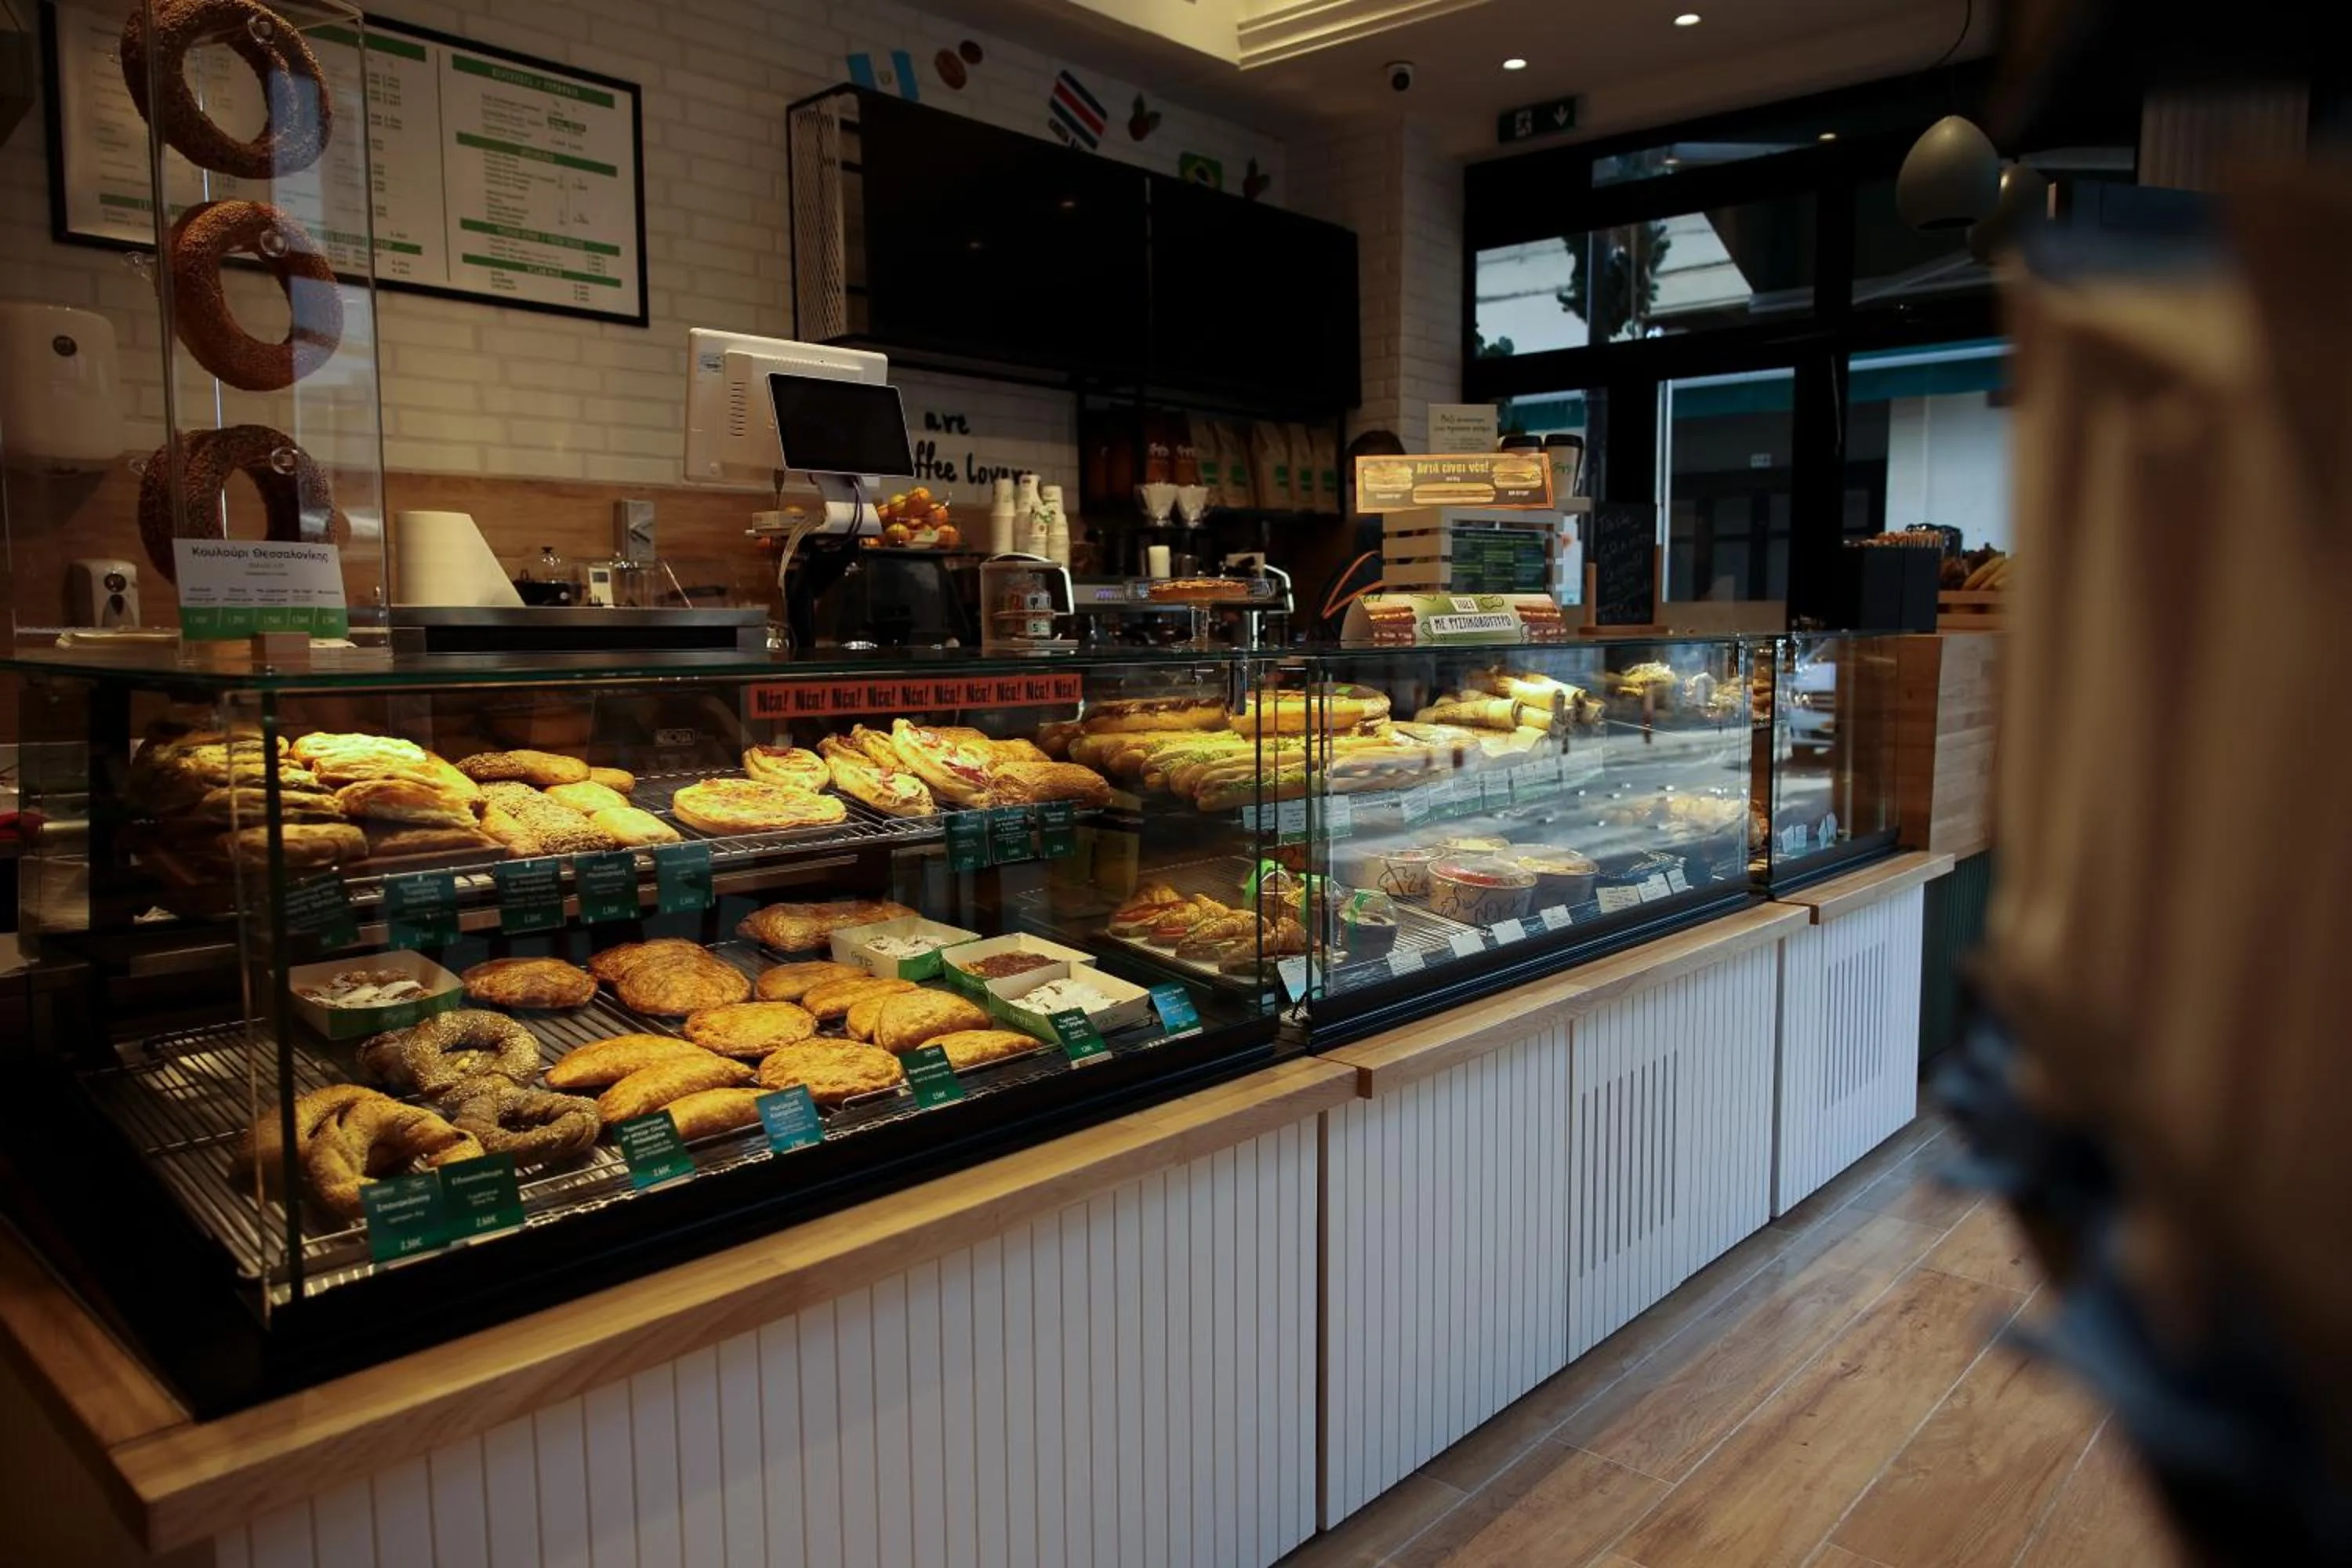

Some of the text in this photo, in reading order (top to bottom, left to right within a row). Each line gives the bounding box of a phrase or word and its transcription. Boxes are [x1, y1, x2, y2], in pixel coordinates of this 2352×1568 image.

[925, 412, 971, 435] are
[915, 439, 957, 481] ffee
[192, 545, 249, 560] Κουλούρι
